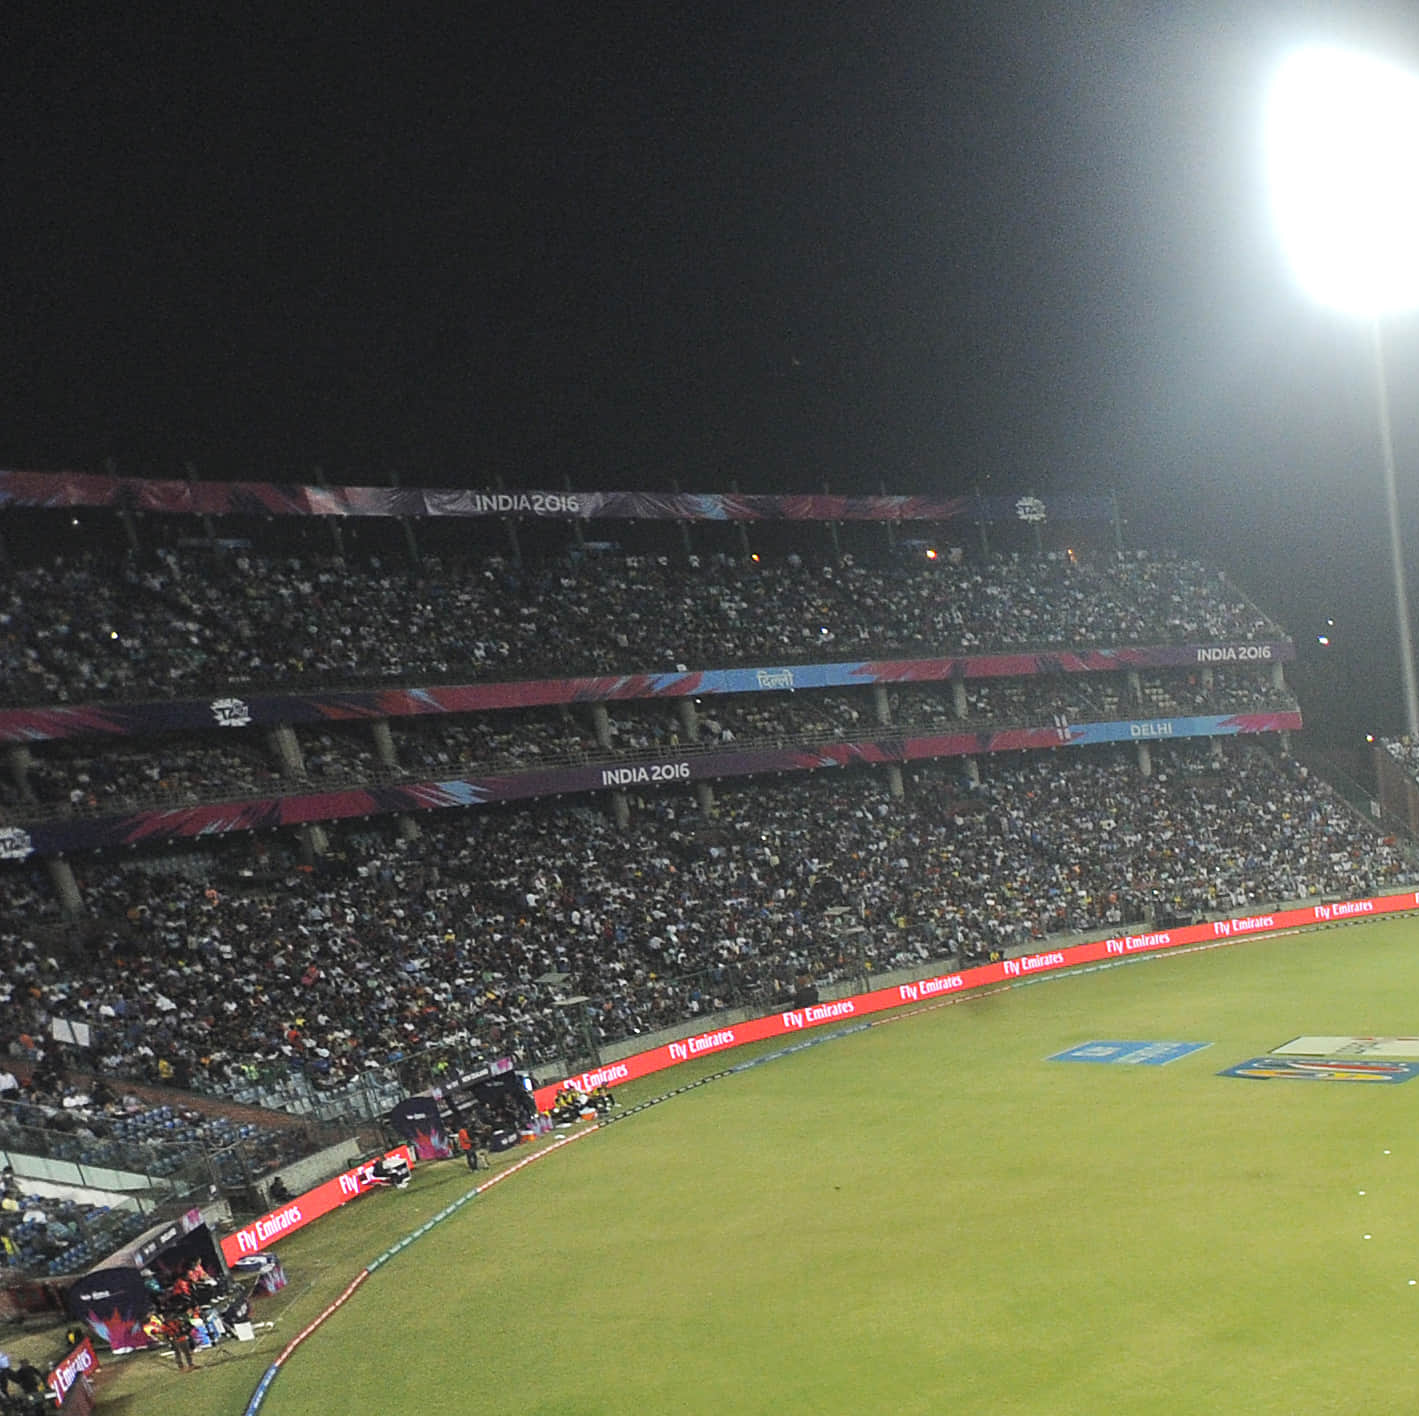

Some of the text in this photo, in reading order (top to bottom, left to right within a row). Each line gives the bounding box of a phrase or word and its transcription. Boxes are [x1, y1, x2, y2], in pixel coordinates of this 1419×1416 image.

[475, 494, 580, 512] INDIA 2016
[1197, 645, 1271, 662] INDIA 2016
[1131, 722, 1172, 737] DELHI
[602, 762, 690, 786] INDIA 2016
[1315, 899, 1373, 920] Fly Emirates
[1214, 916, 1275, 936] Fly Emirates
[1106, 933, 1170, 953] Fly Emirates
[1004, 952, 1065, 976] Fly Emirates
[900, 976, 963, 1001] Fly Emirates
[782, 1000, 854, 1028] Fly Emirates
[670, 1030, 734, 1060] Fly Emirates
[582, 1064, 628, 1090] Emirates
[339, 1172, 360, 1194] Fly
[237, 1206, 302, 1252] Fly Emirates
